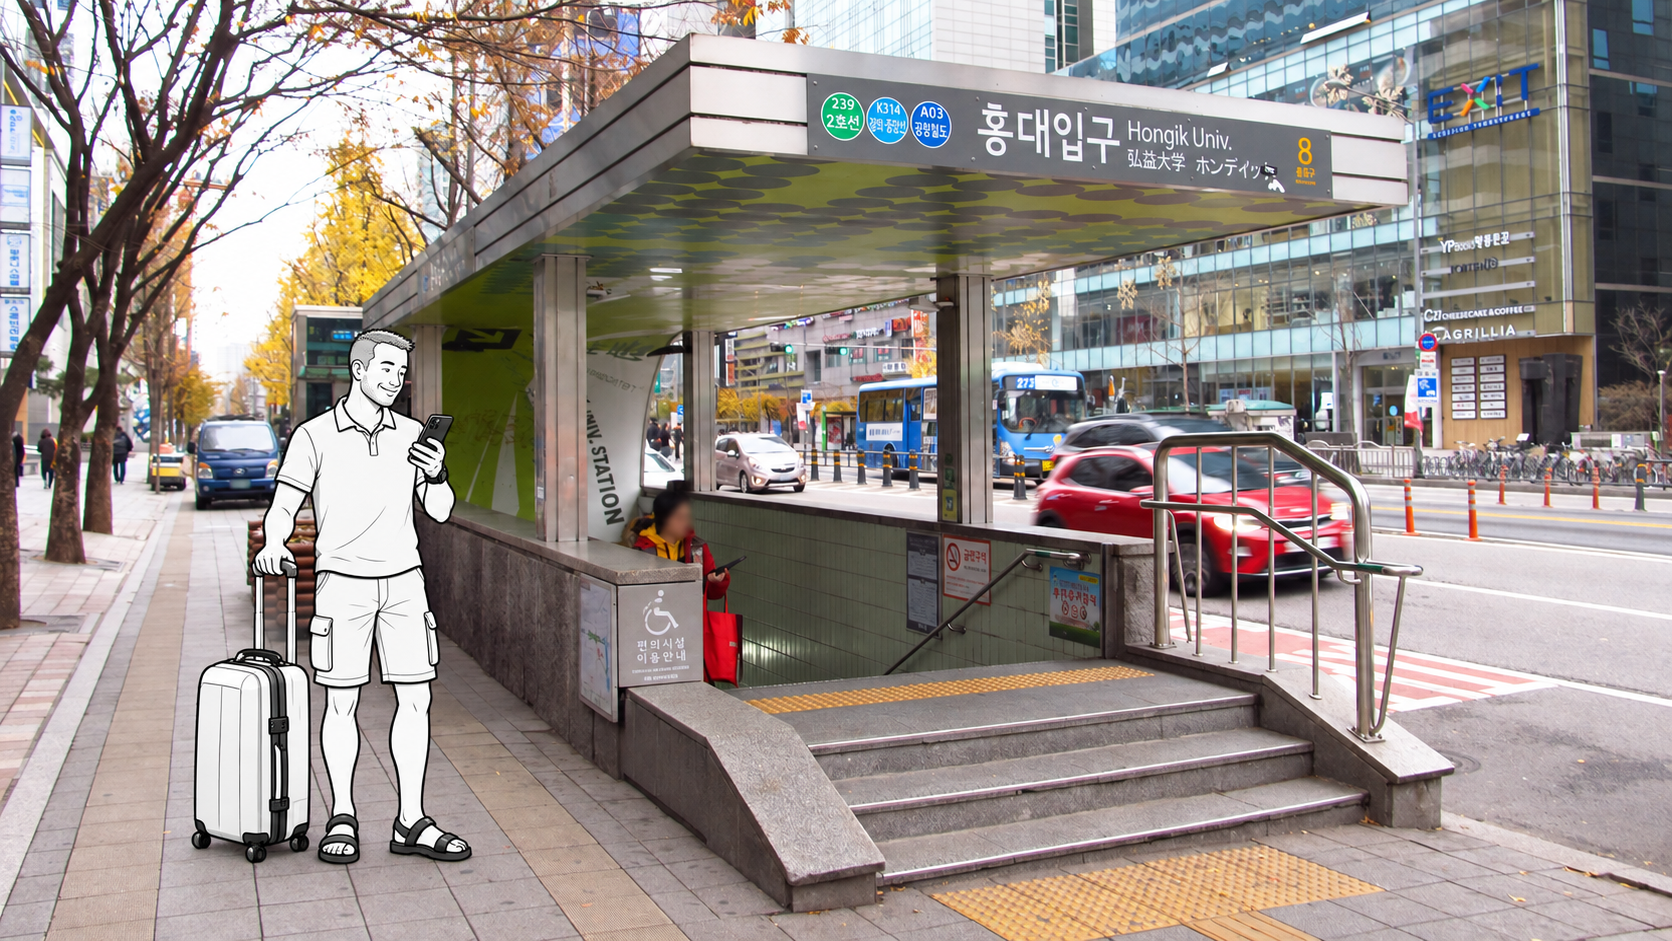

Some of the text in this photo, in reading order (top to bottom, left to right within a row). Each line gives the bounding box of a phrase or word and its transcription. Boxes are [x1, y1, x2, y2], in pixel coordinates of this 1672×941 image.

[831, 97, 855, 111] 239
[1427, 63, 1540, 125] EXIT
[876, 101, 901, 115] K314
[920, 105, 944, 119] A03
[826, 113, 860, 131] 2호선
[977, 102, 1121, 164] 홍대입구
[1127, 119, 1232, 151] Hongik Univ.
[1127, 148, 1186, 172] 弘益大学
[1297, 137, 1313, 165] 8
[591, 445, 625, 526] STATION
[636, 636, 685, 652] 편의시설
[636, 649, 686, 665] 이용안내
